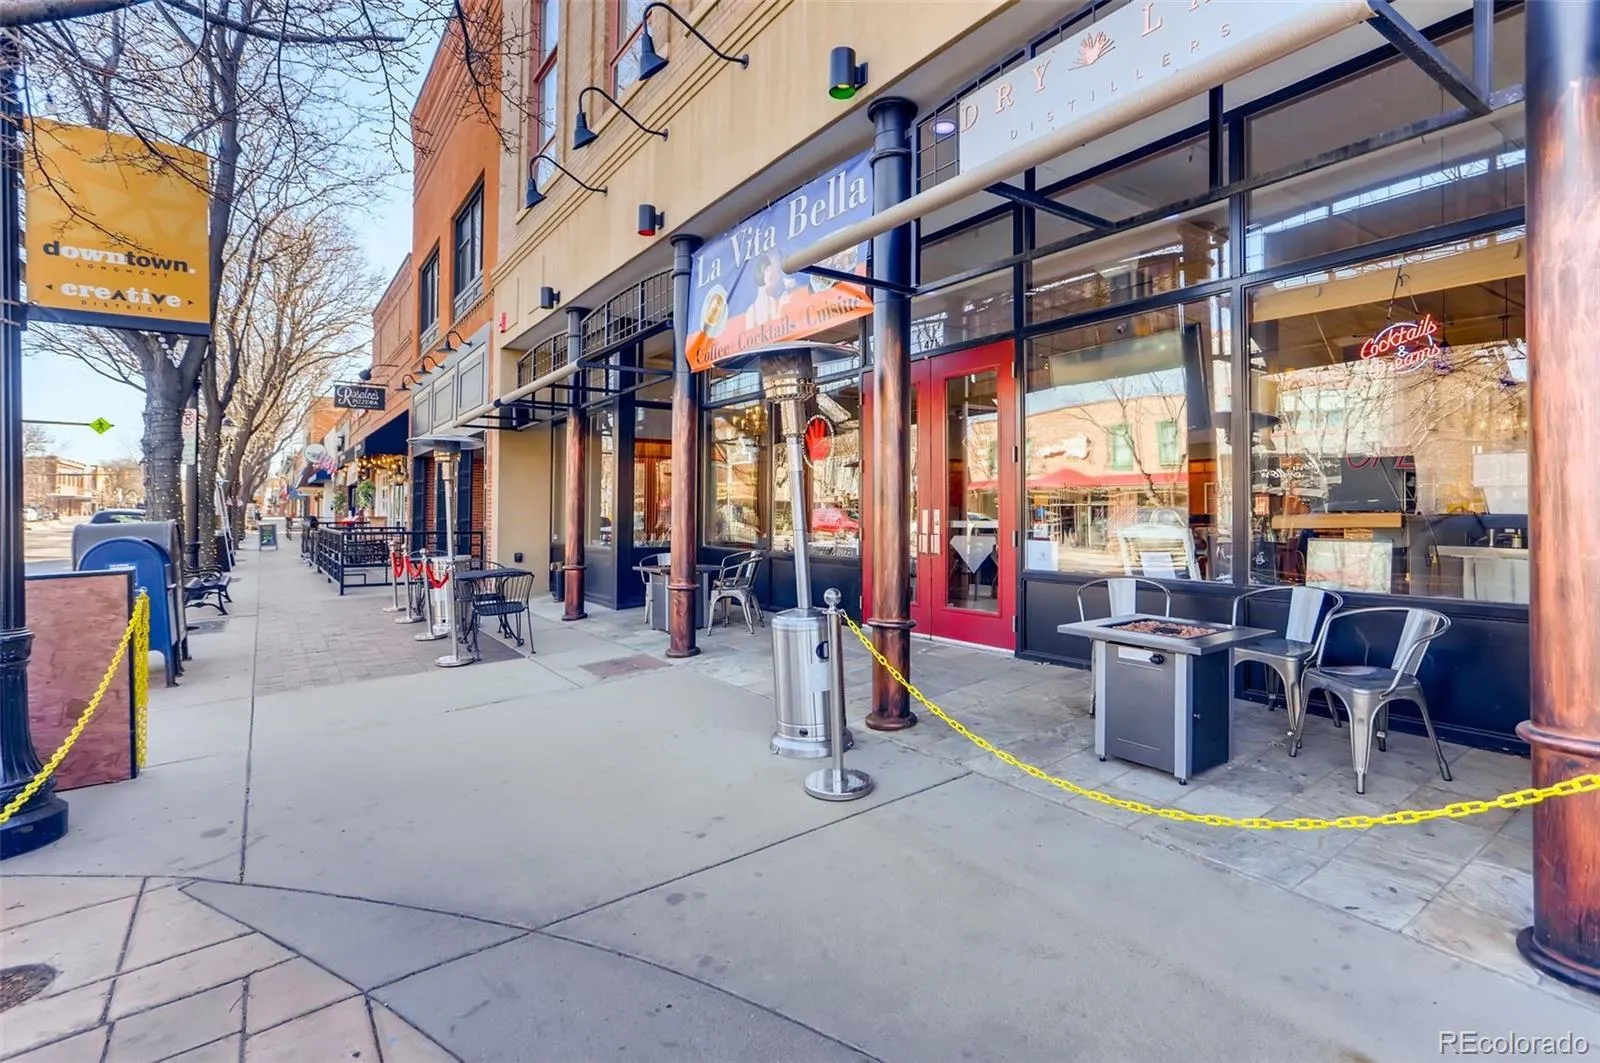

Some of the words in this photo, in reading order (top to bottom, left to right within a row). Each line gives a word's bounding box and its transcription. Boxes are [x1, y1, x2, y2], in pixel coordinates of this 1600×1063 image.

[960, 59, 1051, 134] DRY
[1010, 23, 1231, 140] DISTILLERS
[697, 255, 721, 289] La
[730, 226, 776, 269] Vita
[787, 170, 868, 241] Bella
[76, 262, 169, 279] LONGMONT
[81, 299, 164, 313] DISTRICT
[696, 343, 731, 365] Coffee
[737, 314, 797, 352] Cocktails
[806, 295, 862, 329] Cuisine
[1361, 313, 1437, 360] Cocktails
